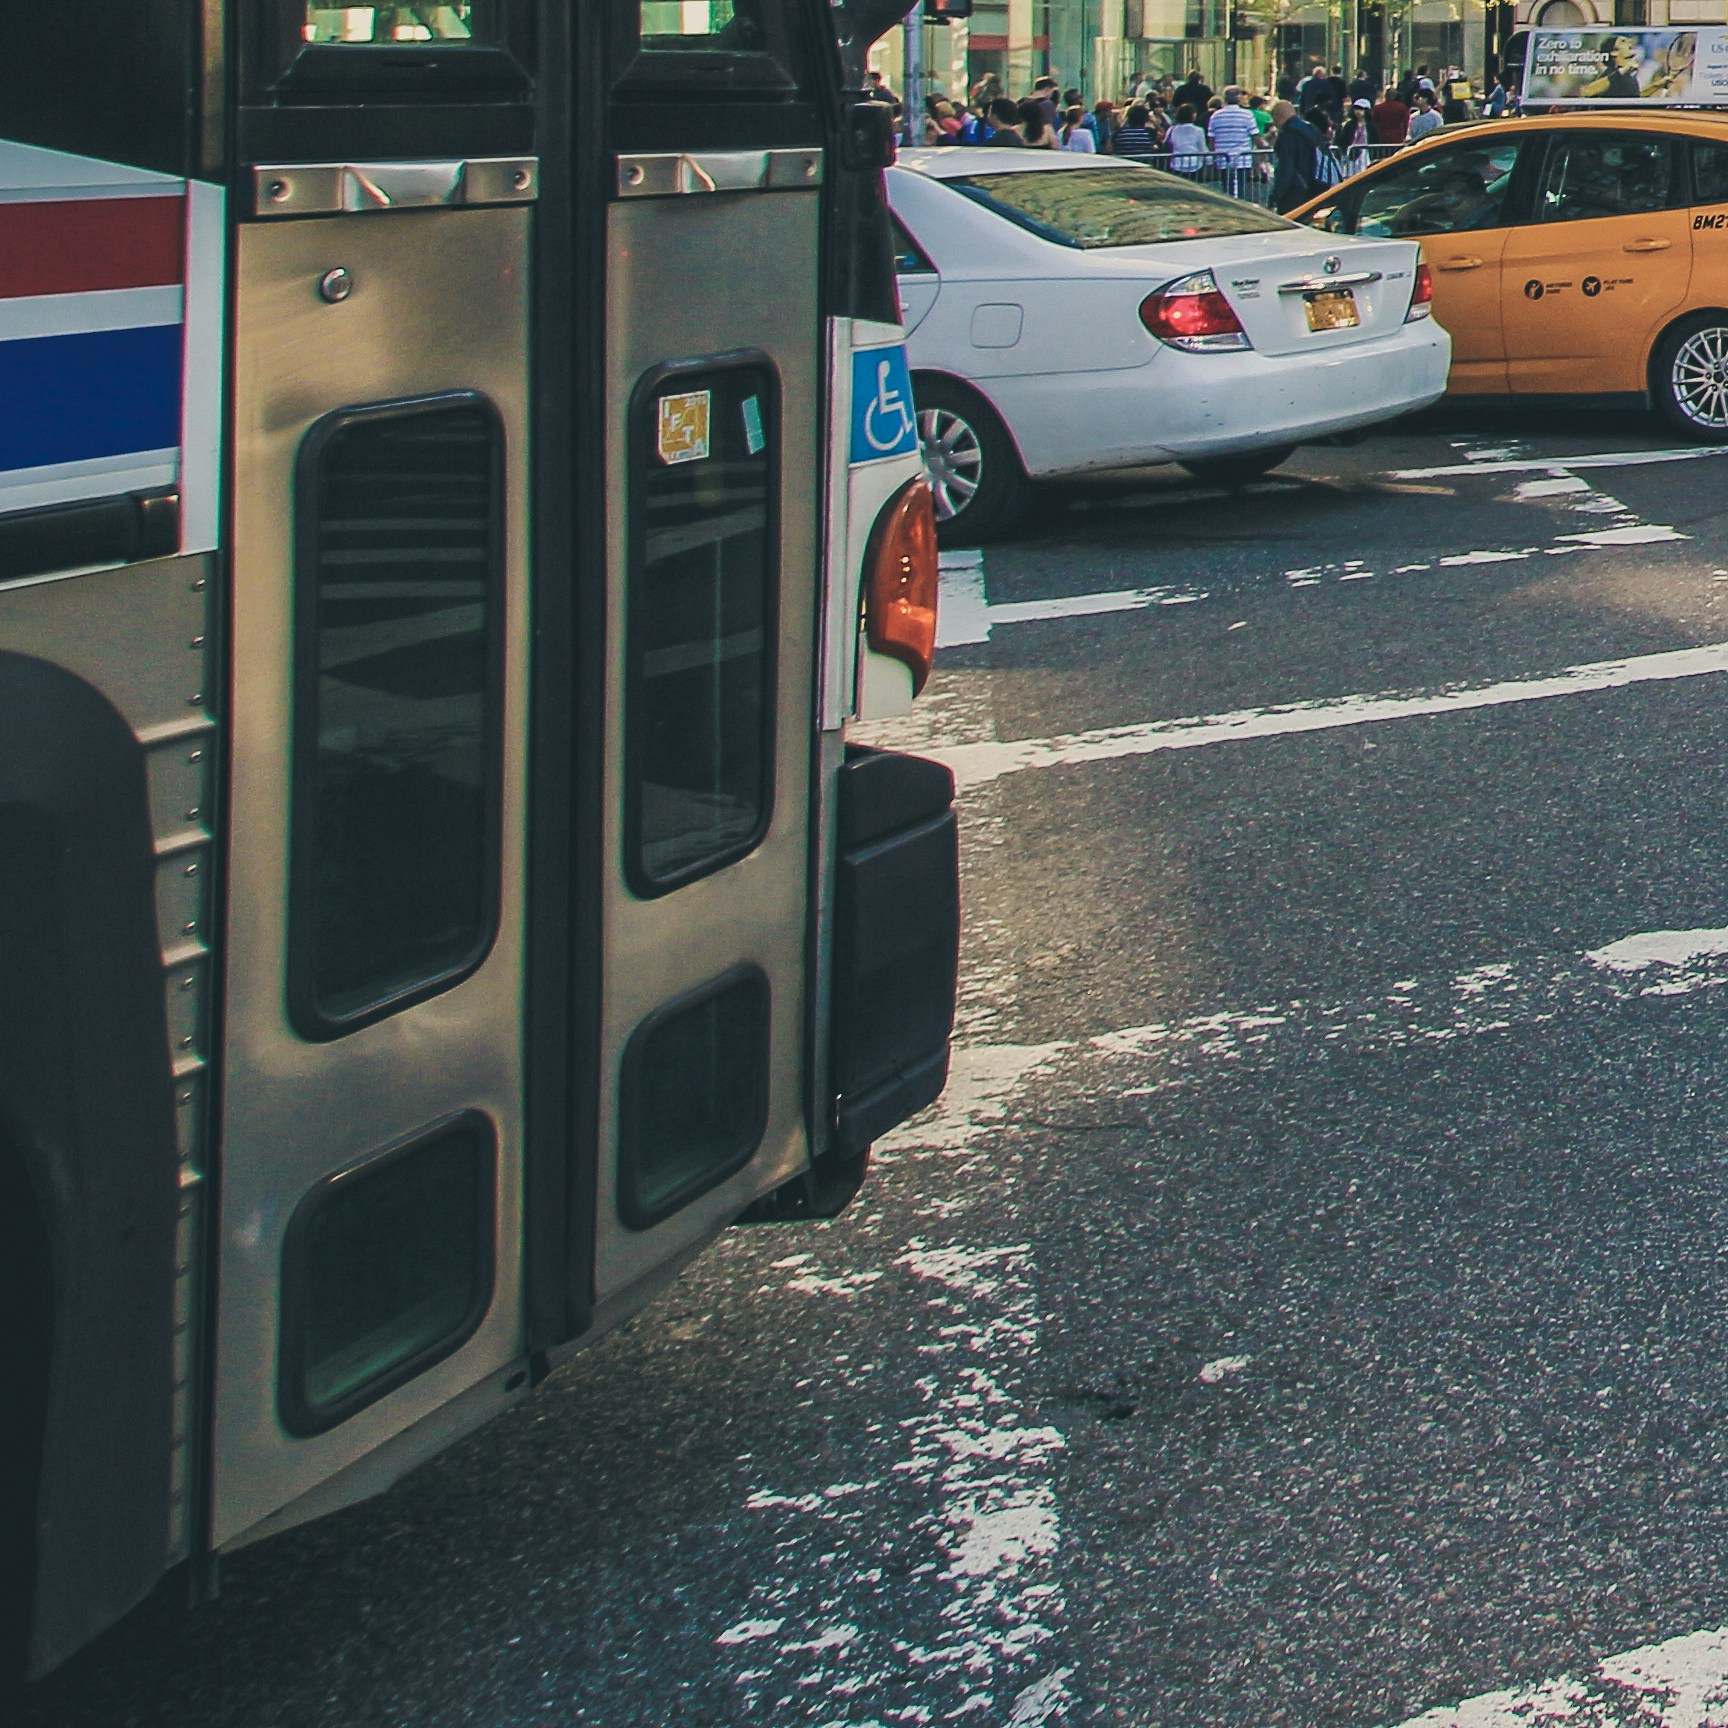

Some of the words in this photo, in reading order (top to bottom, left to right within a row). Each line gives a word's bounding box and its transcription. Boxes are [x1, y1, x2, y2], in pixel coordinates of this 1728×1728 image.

[1538, 37, 1567, 50] Zero
[1569, 36, 1582, 49] to
[1711, 43, 1724, 53] US
[1537, 50, 1609, 62] exhilaration
[1535, 63, 1547, 75] in
[1549, 65, 1565, 75] no
[1568, 63, 1599, 75] time.
